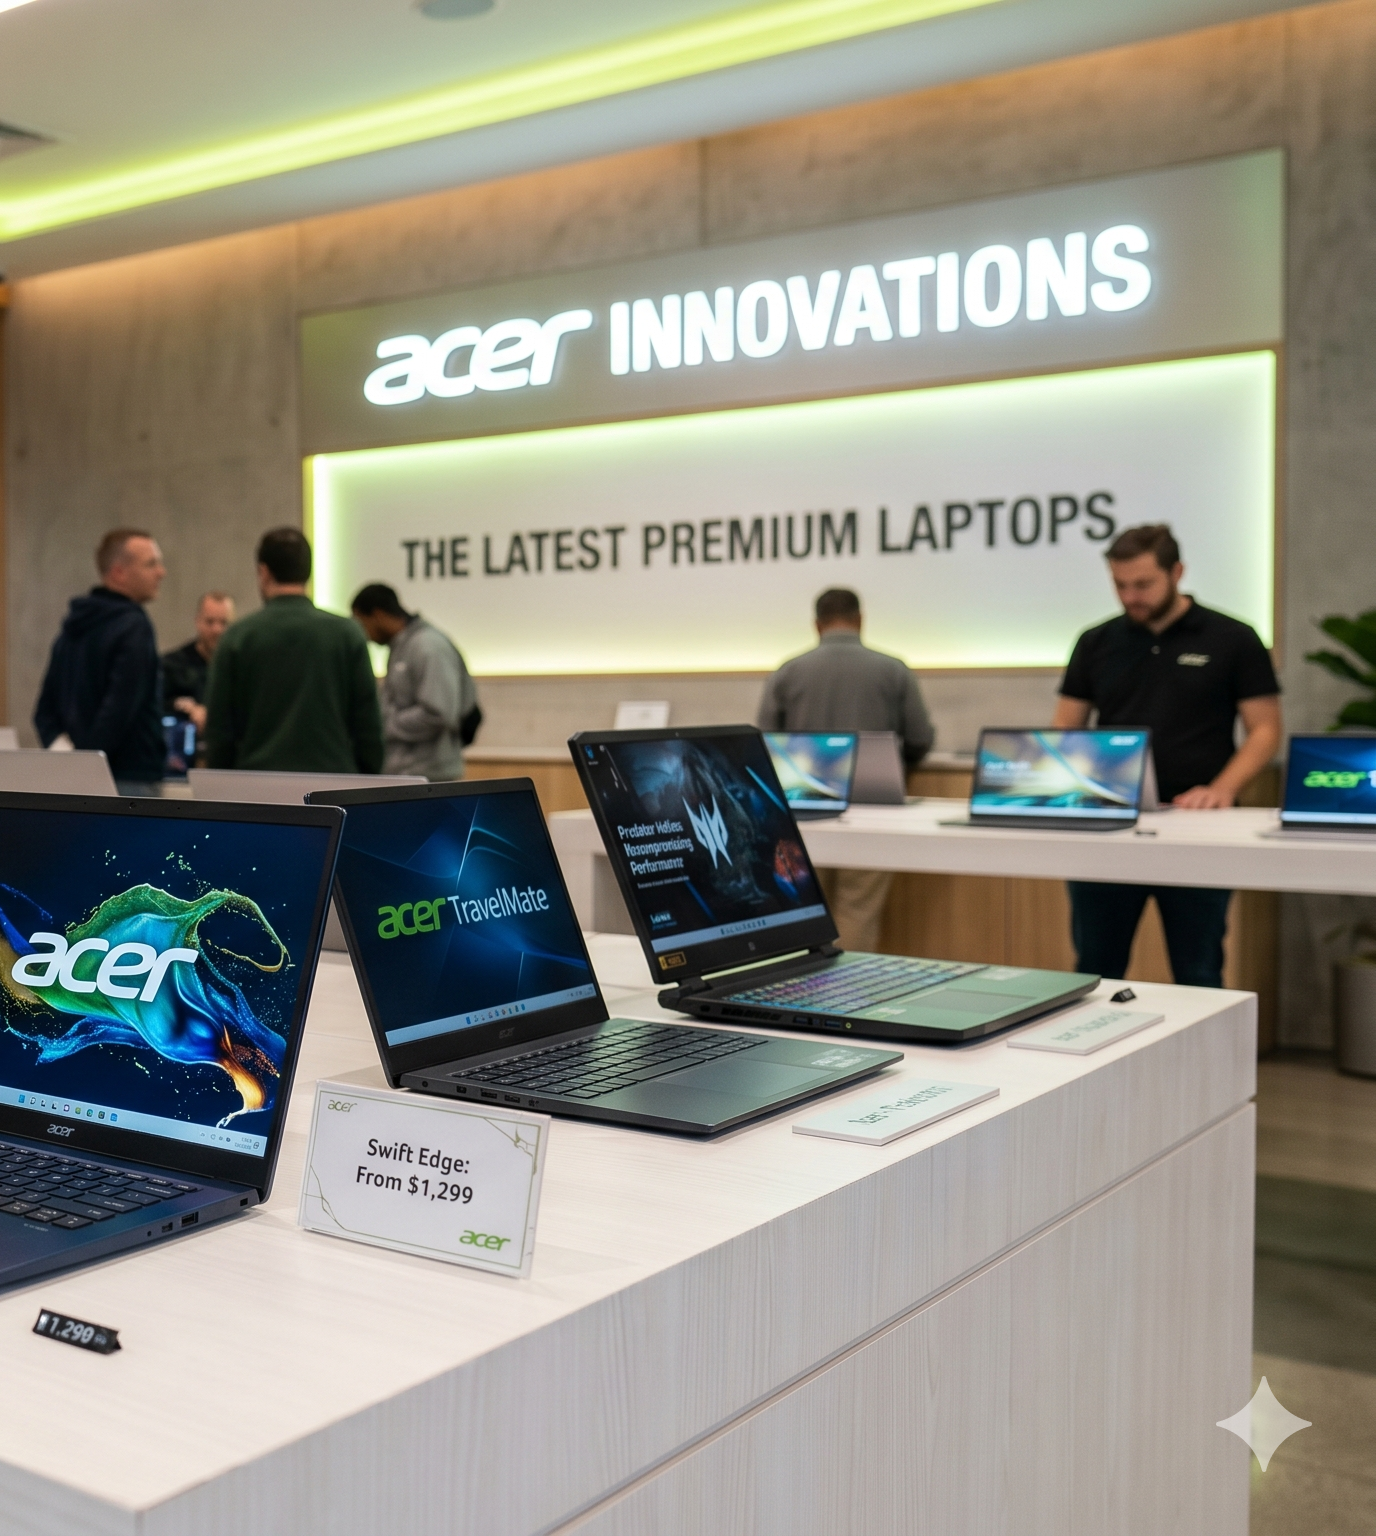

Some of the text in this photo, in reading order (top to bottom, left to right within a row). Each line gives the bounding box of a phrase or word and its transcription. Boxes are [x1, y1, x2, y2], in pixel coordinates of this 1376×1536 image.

[362, 223, 1152, 407] acer INNOVATIONS
[401, 491, 1119, 581] THE LATEST PREMIUM LAPTOPS
[1303, 770, 1368, 788] acer
[377, 885, 550, 940] acer TravelMate
[11, 931, 199, 1003] acer
[327, 1100, 357, 1113] acer
[46, 1123, 76, 1138] acer
[366, 1138, 471, 1176] Swift Edge:
[356, 1165, 474, 1205] From $1,299
[459, 1229, 512, 1252] acer
